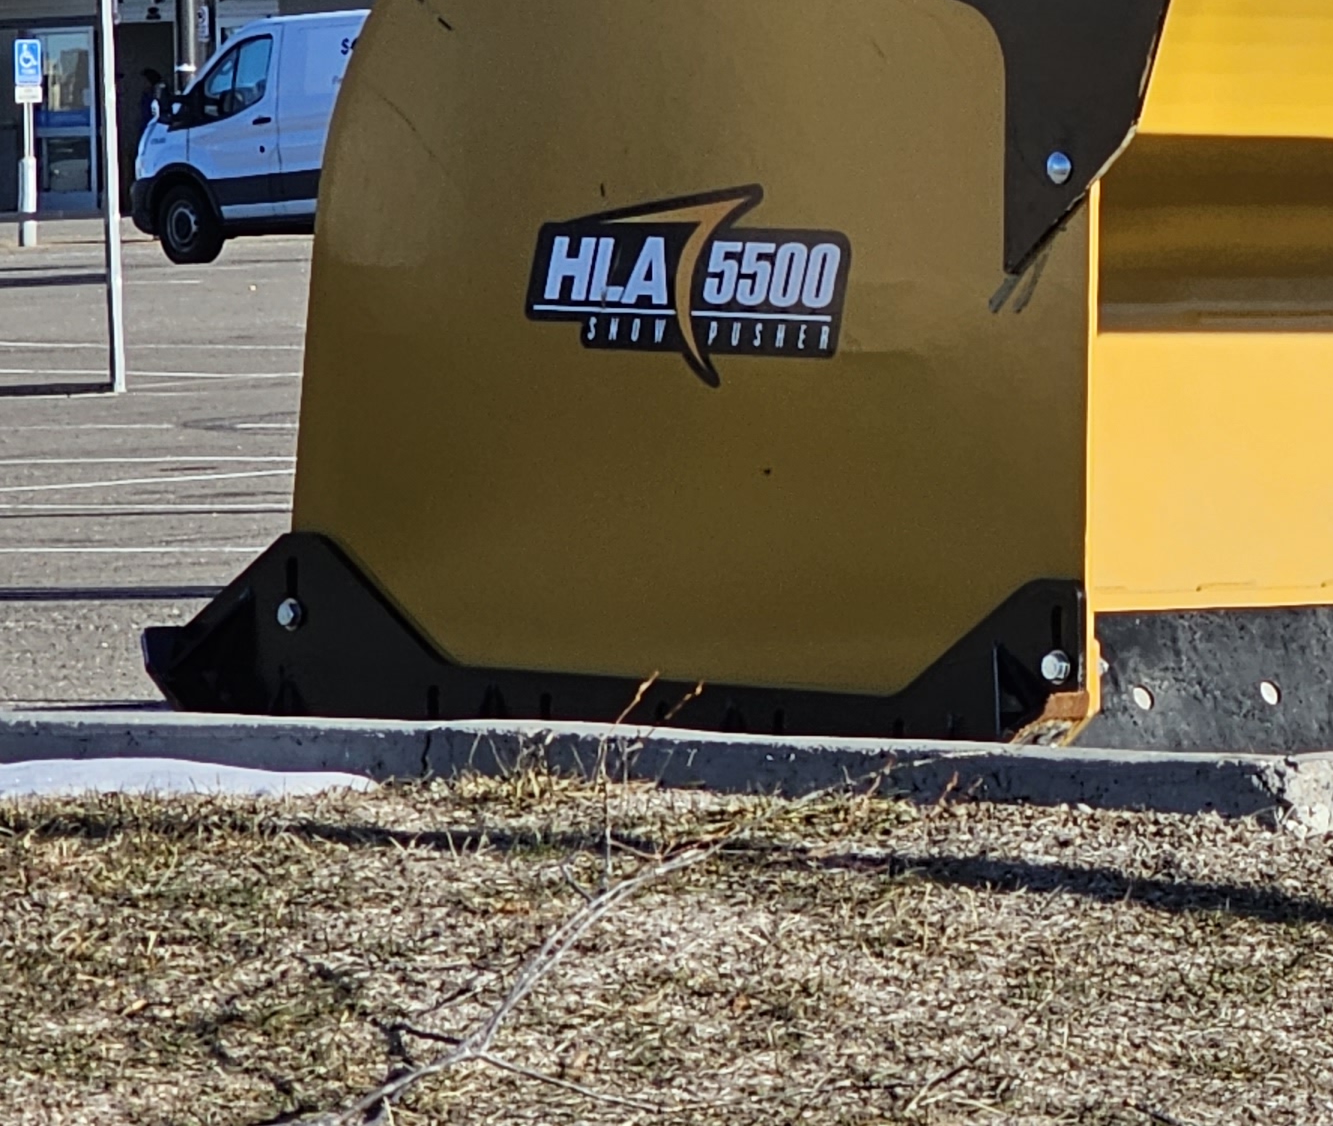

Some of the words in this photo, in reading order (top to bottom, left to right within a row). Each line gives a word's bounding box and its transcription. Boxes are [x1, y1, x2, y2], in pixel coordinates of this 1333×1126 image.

[543, 235, 668, 305] HLA
[702, 239, 842, 309] 5500
[586, 316, 667, 344] SNOW
[707, 320, 831, 351] PUSHER
